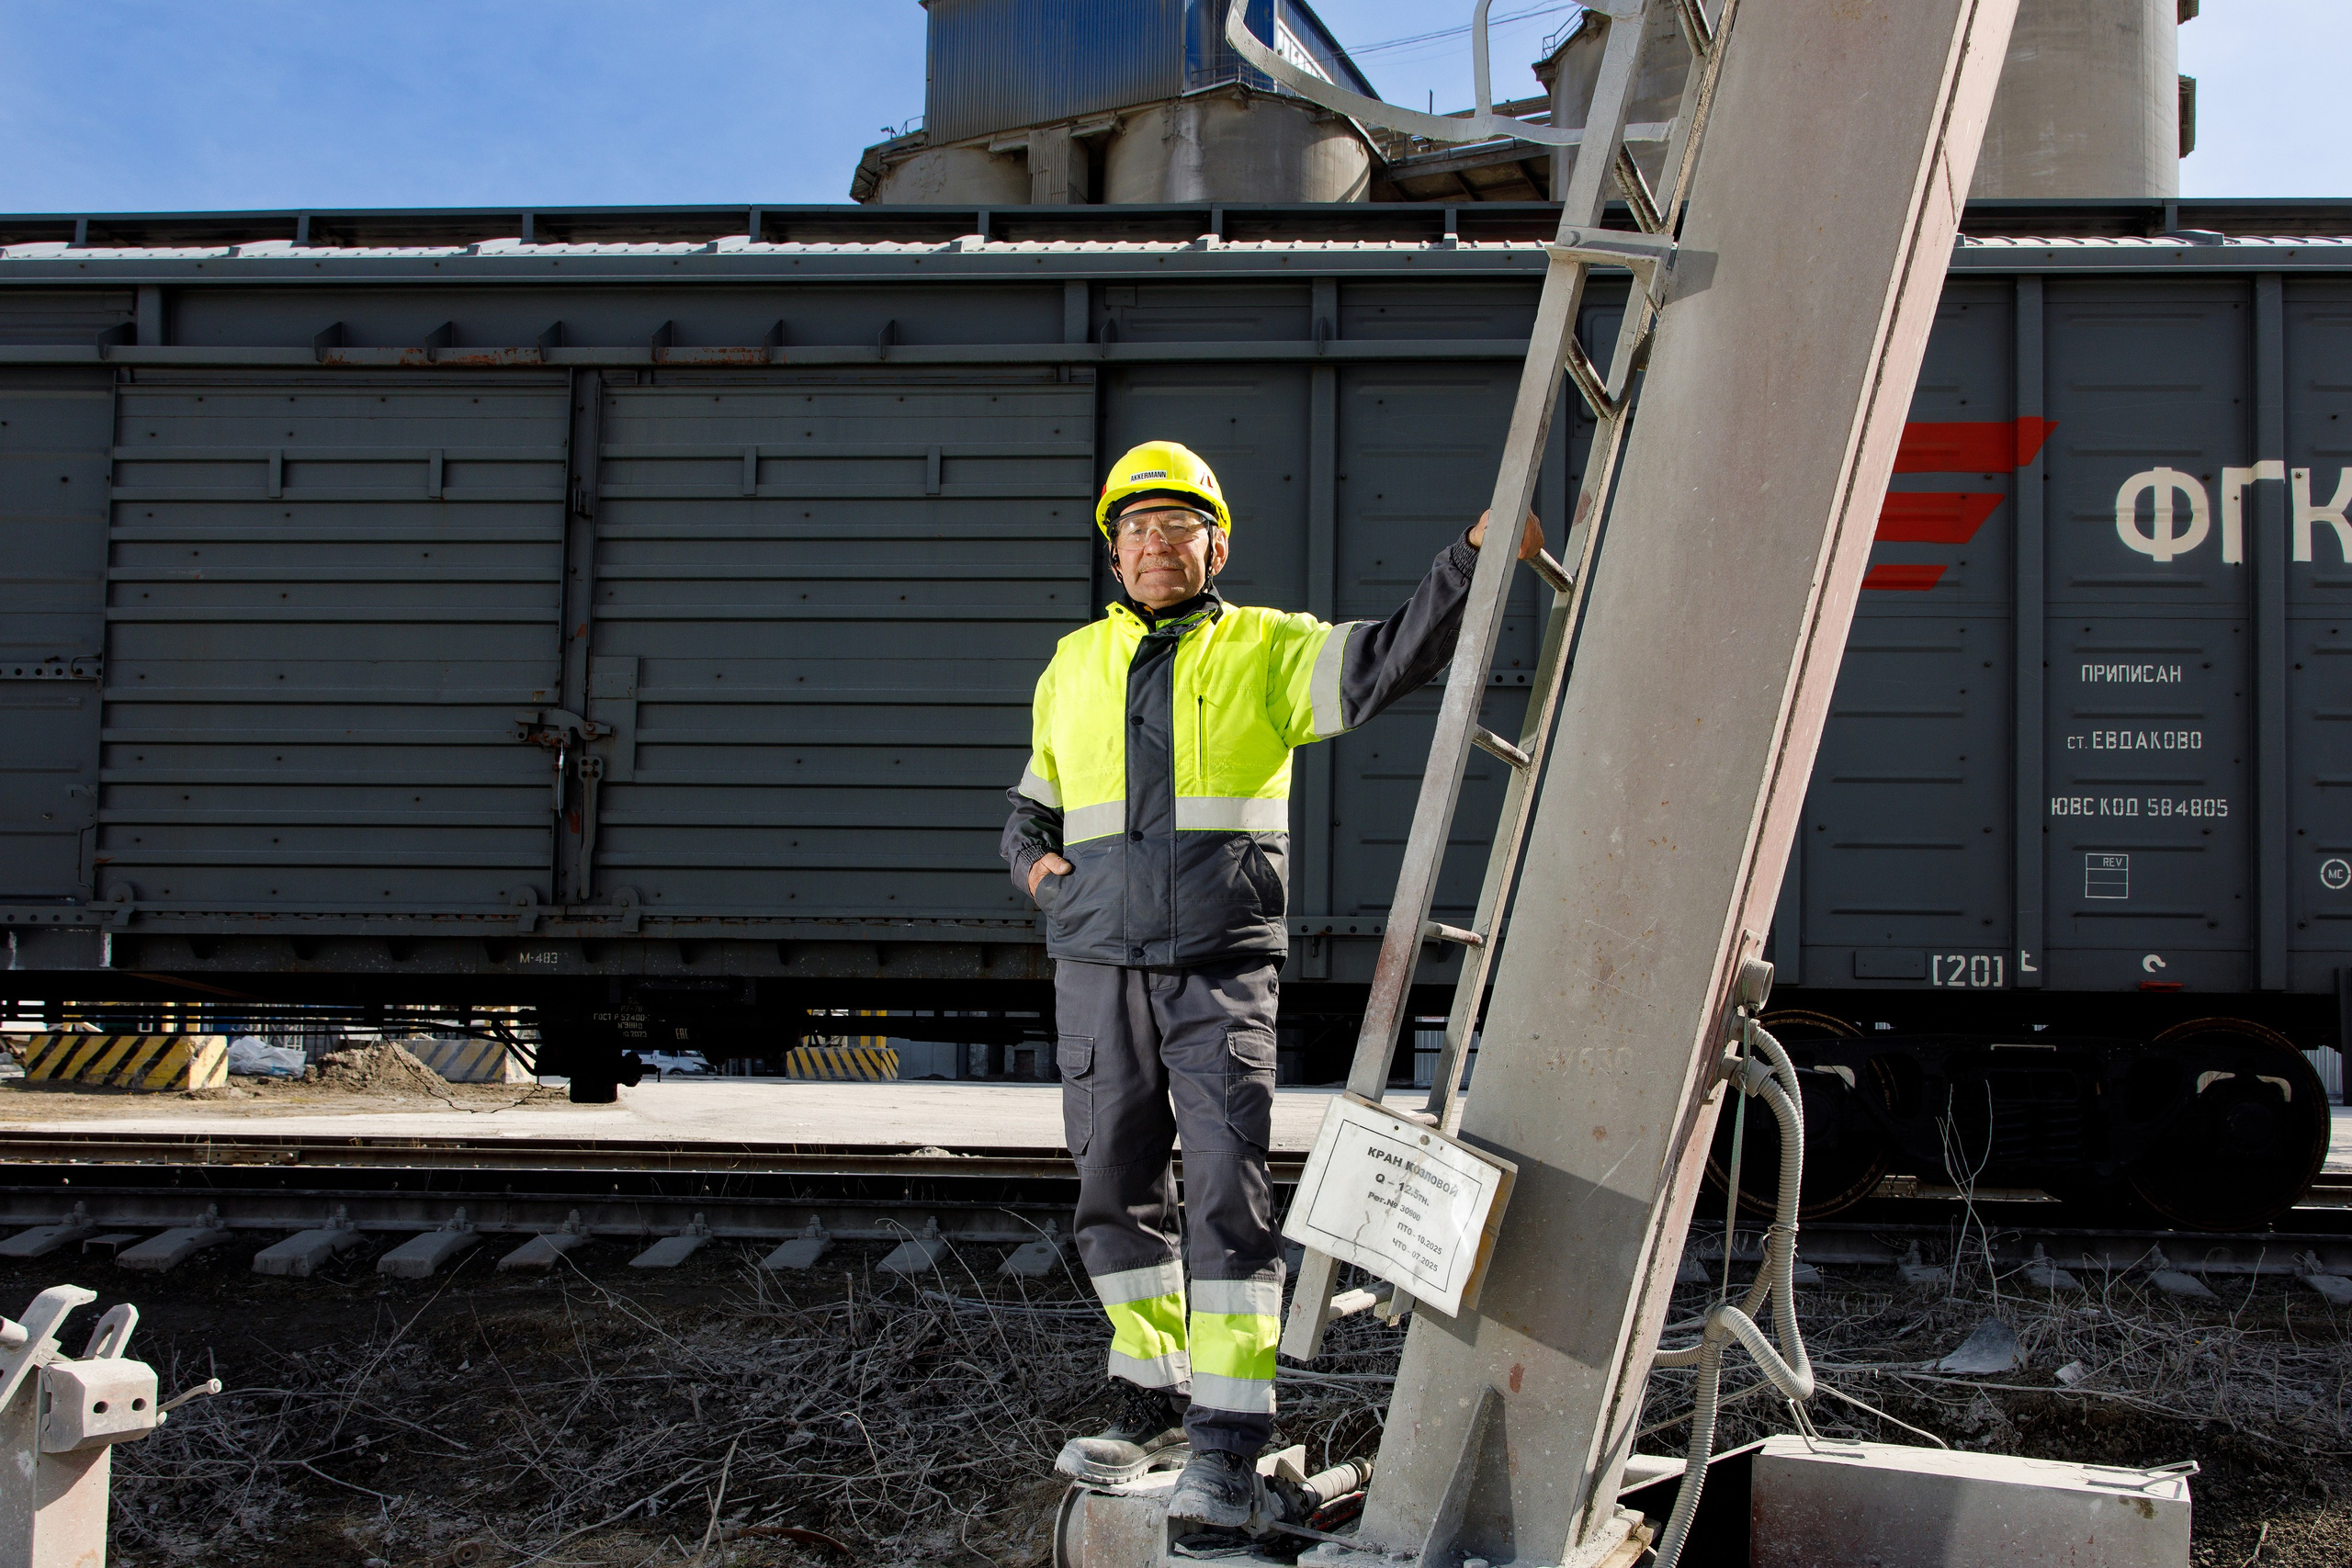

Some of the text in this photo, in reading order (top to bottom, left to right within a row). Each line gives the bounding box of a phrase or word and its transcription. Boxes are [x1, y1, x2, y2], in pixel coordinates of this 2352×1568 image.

[1130, 471, 1166, 482] AKKERMANN
[2115, 460, 2352, 564] ФГК
[2081, 664, 2181, 682] ПРИПИСАН
[2092, 731, 2202, 750] ЕВДАКОВО
[2051, 797, 2228, 817] ЮВС КОД 584805
[2102, 857, 2122, 867] REV
[519, 952, 558, 964] М-483
[593, 1012, 612, 1021] ГОСТ
[675, 1028, 689, 1040] EAC
[1367, 1146, 1459, 1198] КРАН КОЗЛОВОЙ
[1375, 1173, 1385, 1185] Q
[1396, 1222, 1413, 1235] ПТО
[1417, 1235, 1442, 1256] 10.2025
[1392, 1237, 1407, 1251] ЧТО
[1411, 1251, 1438, 1272] 07.2025
